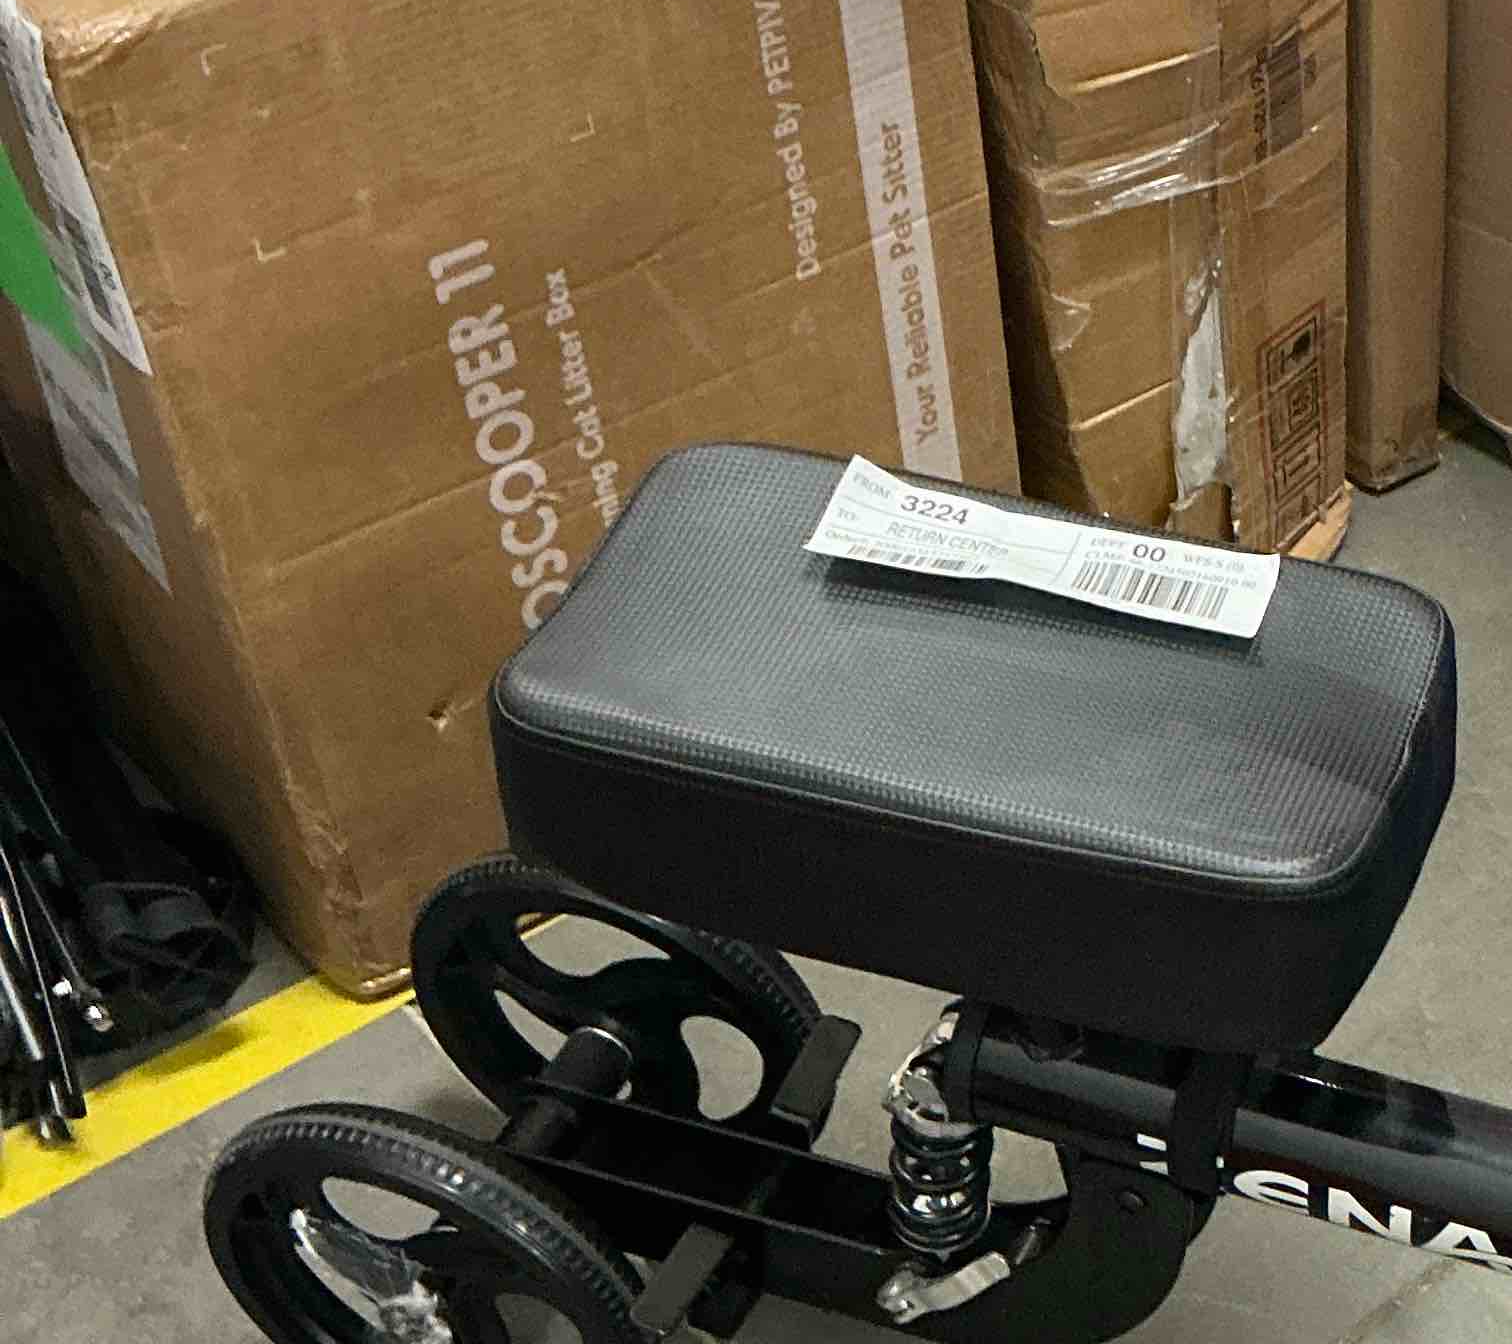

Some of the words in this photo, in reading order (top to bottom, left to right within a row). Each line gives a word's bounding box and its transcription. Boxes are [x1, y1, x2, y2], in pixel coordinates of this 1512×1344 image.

[879, 121, 911, 207] Sitter
[776, 142, 822, 282] Designed
[888, 207, 916, 262] Pet
[427, 237, 497, 306] 11
[545, 266, 576, 327] Box
[899, 261, 932, 382] Reliable
[559, 328, 594, 407] Litter
[573, 404, 606, 461] Cat
[914, 382, 940, 446] Your
[884, 520, 947, 548] RETURN
[900, 494, 970, 526] 3224
[1132, 543, 1167, 563] 00
